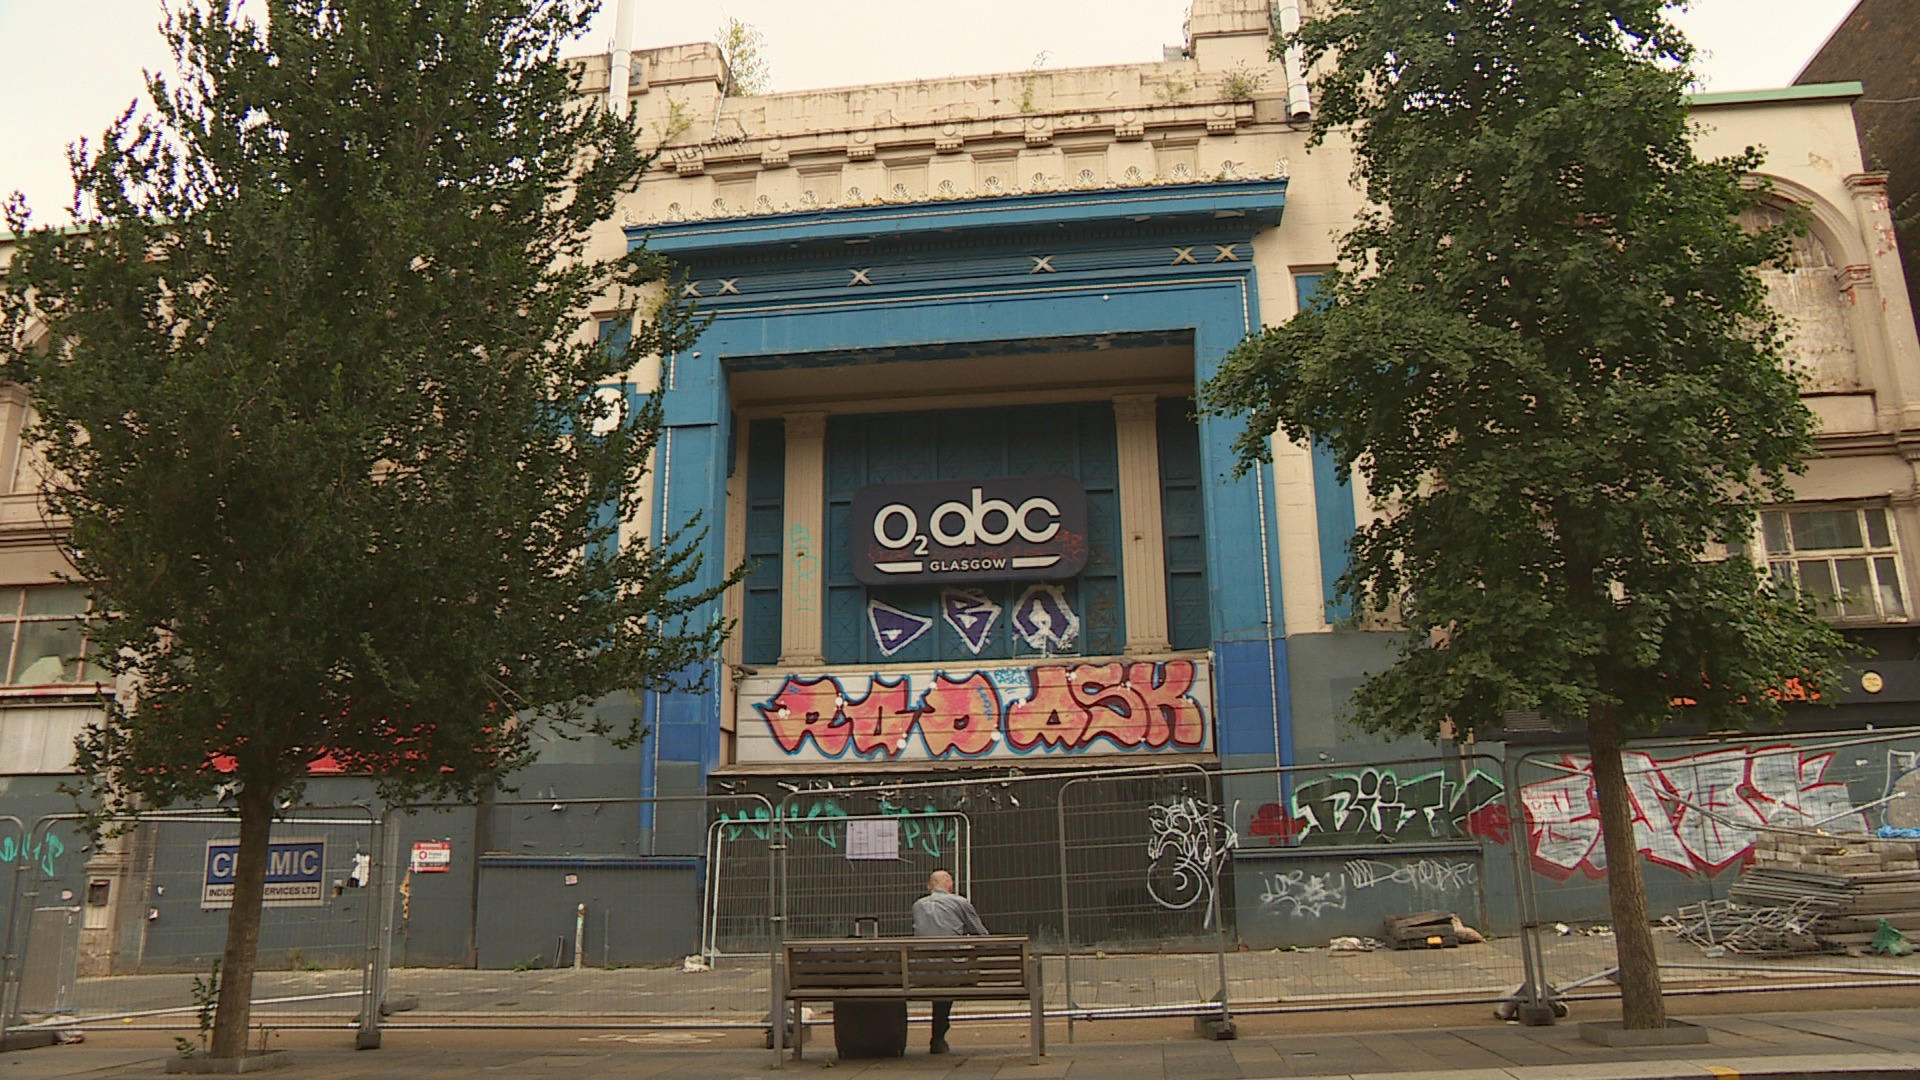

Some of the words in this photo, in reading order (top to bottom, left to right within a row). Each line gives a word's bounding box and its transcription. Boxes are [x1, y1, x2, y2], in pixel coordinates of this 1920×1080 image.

[929, 487, 1061, 547] abc
[929, 558, 1007, 572] GLASGOW
[211, 849, 319, 878] CMIC
[263, 885, 300, 896] ERVICES
[301, 885, 318, 895] LTD
